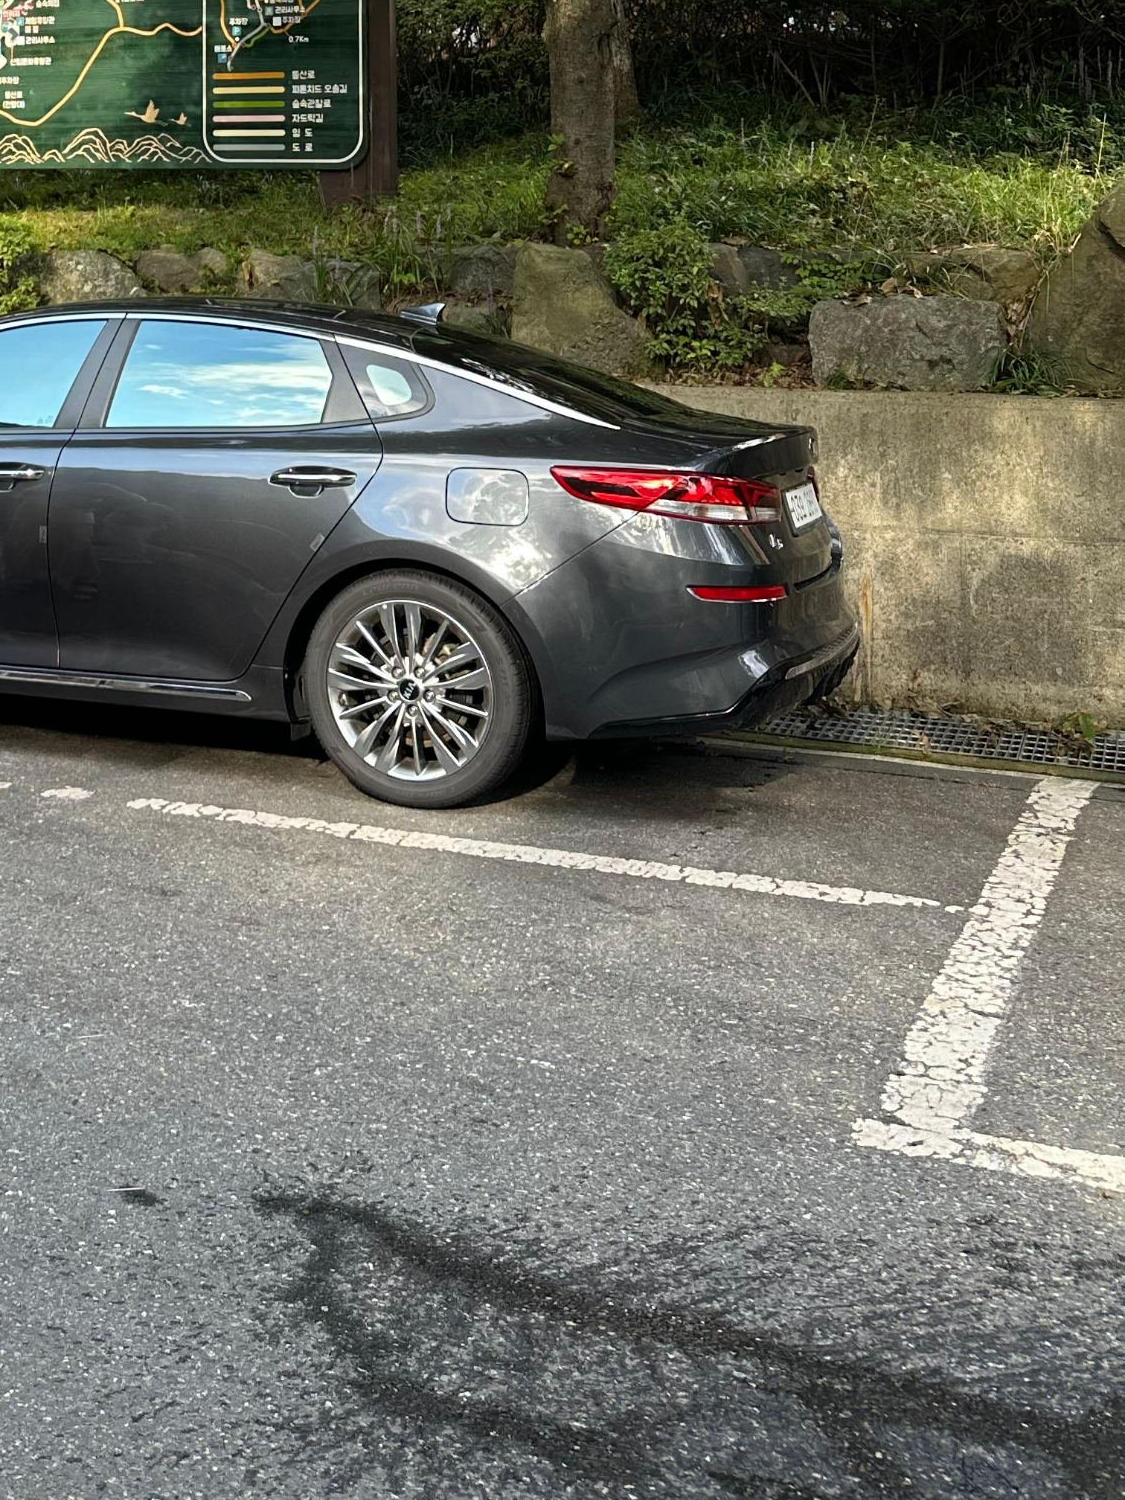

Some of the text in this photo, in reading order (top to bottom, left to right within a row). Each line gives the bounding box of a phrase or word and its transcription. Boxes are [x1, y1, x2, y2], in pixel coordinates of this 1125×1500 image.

[36, 0, 60, 8] 숲속의집
[275, 6, 305, 14] 관리사무소
[229, 17, 248, 26] 주차장
[26, 36, 55, 44] 관리사무소
[292, 70, 316, 79] 등산로
[292, 84, 348, 94] 피톤치드 오솔길
[292, 99, 331, 109] 숲속관찰로
[292, 113, 324, 123] 자드락길
[292, 128, 313, 138] 임 도
[292, 143, 313, 152] 도 로
[403, 682, 417, 700] KIA
